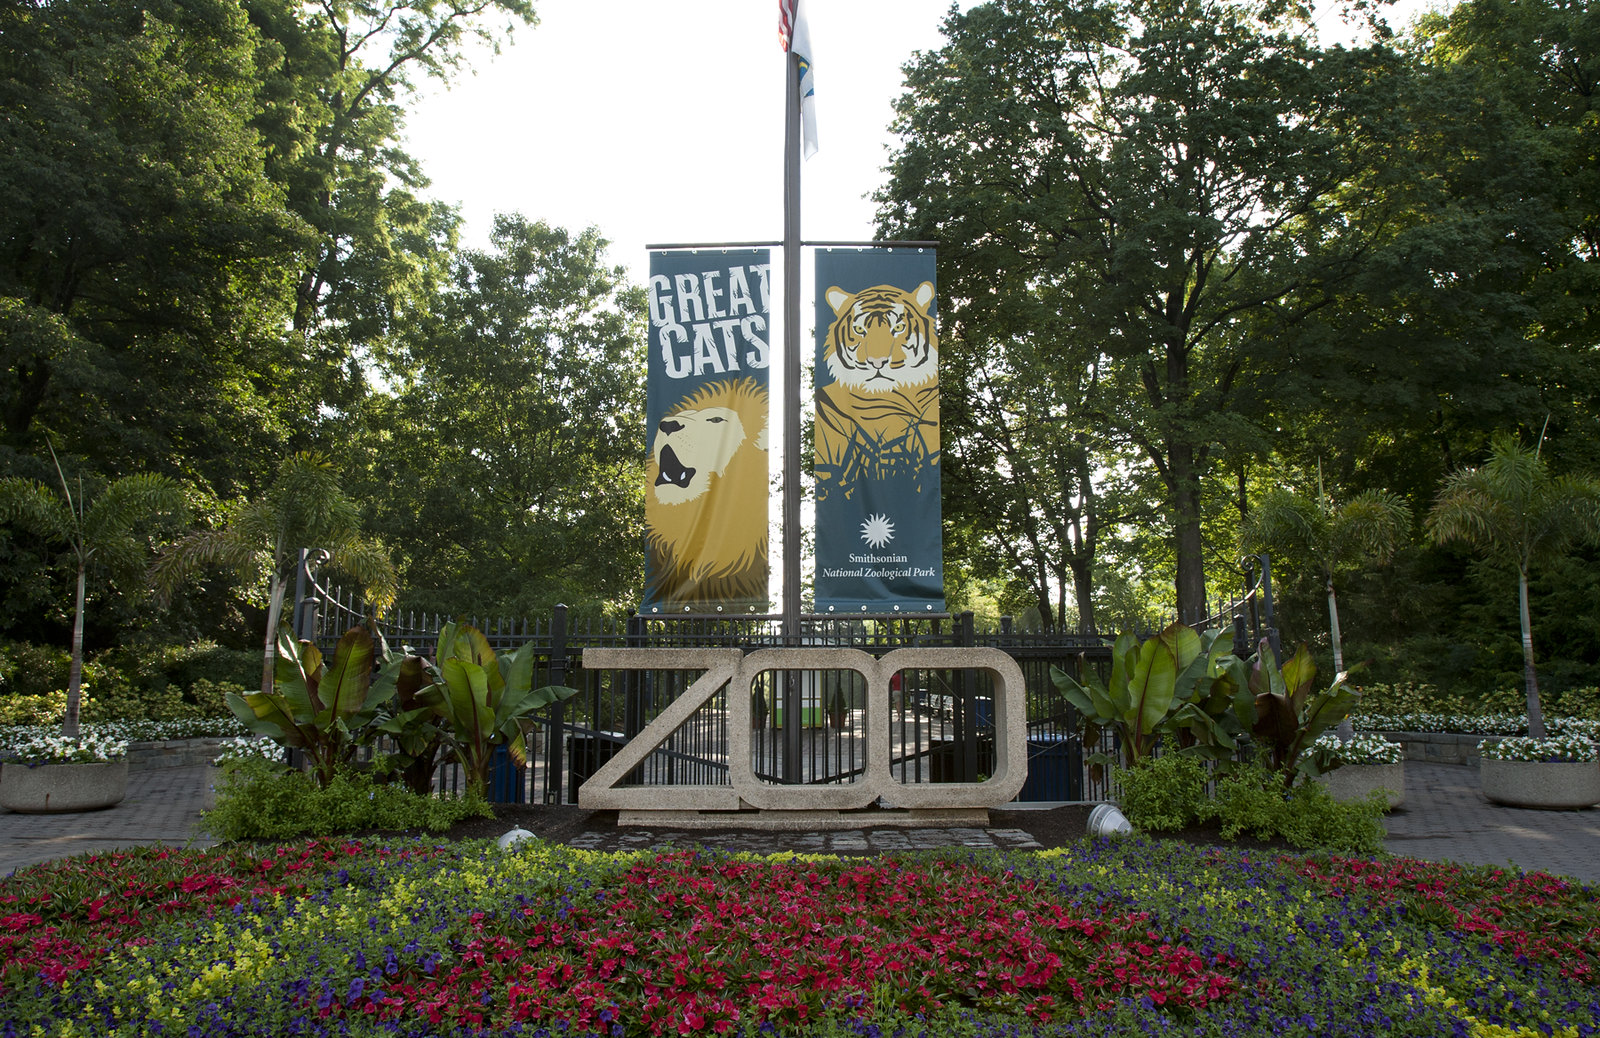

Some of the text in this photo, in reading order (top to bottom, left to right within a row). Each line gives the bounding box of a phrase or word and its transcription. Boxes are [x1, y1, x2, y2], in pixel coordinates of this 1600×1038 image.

[649, 264, 770, 327] GREAT
[658, 314, 770, 379] CATS
[822, 567, 935, 580] National Zoological Park
[849, 553, 908, 563] Smithsonian
[578, 647, 1028, 811] ZOO
